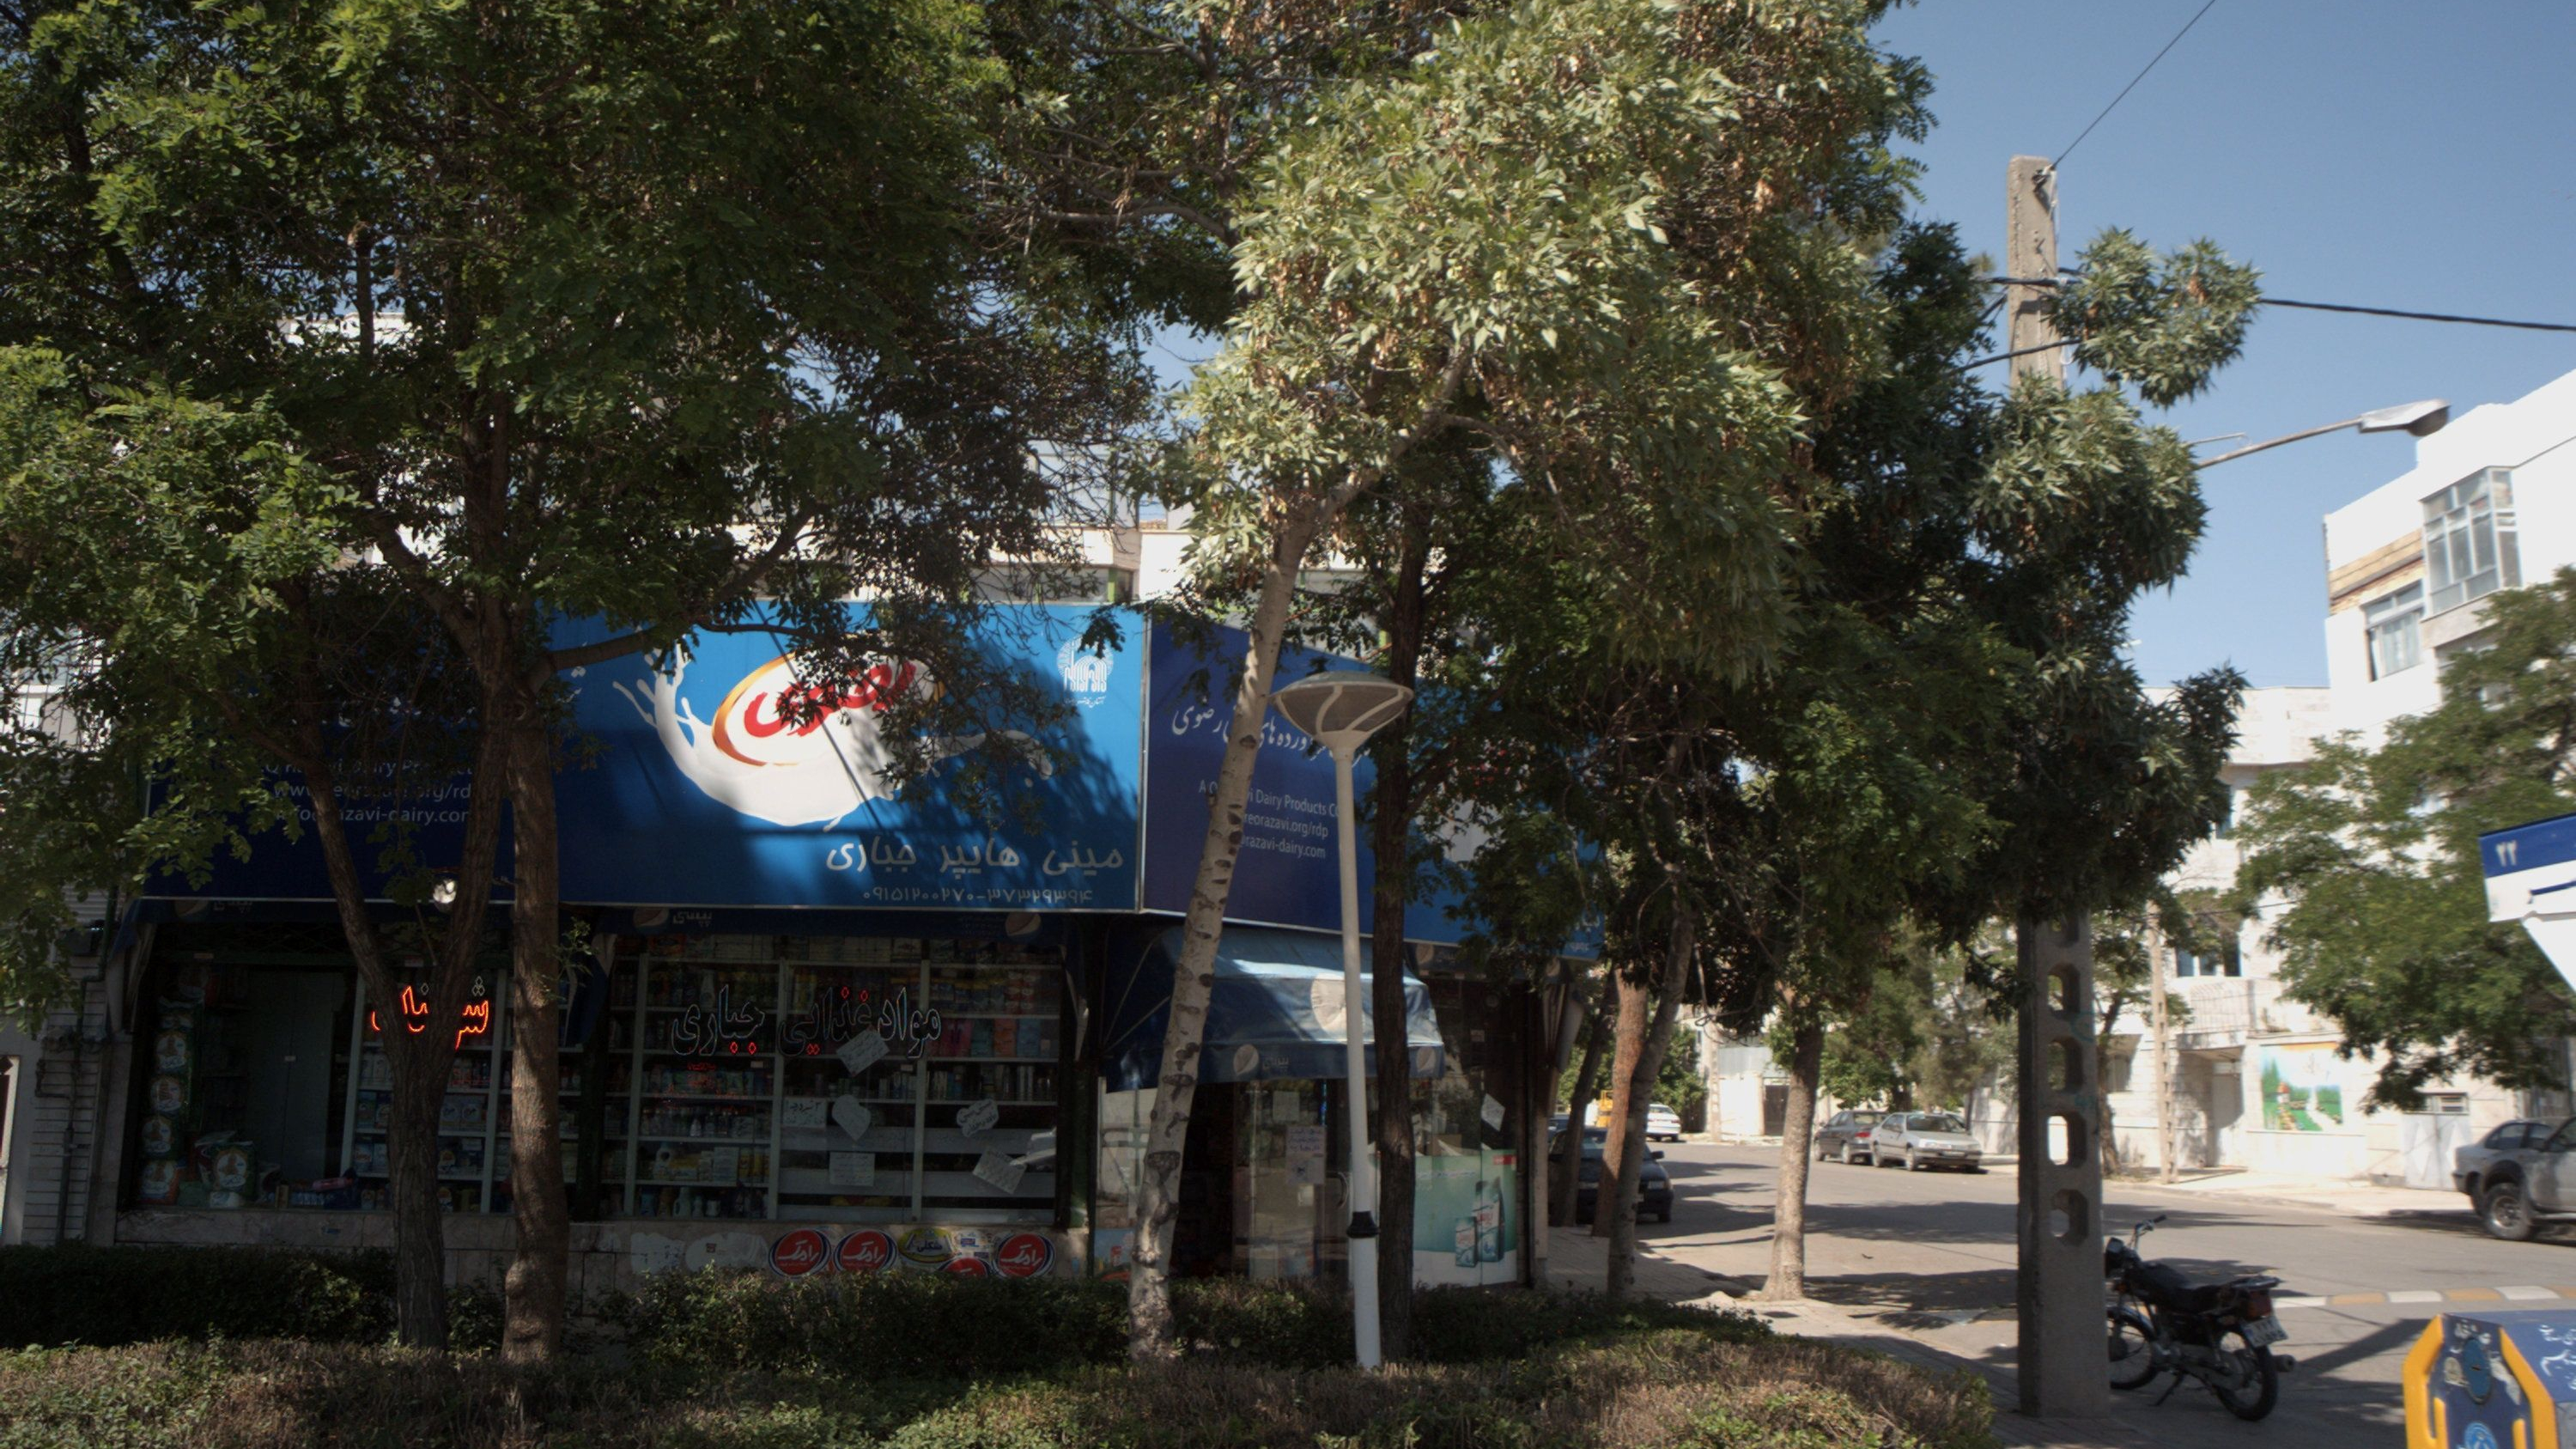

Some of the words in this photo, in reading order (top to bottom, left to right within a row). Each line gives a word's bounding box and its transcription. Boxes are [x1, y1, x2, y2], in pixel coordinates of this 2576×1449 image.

[1171, 697, 1224, 736] رضوی
[1255, 789, 1283, 810] Dairy
[1284, 795, 1327, 815] Products
[826, 835, 917, 874] جباری
[939, 837, 1021, 881] هایپر
[1042, 839, 1125, 877] مینی
[671, 983, 767, 1056] جباری
[875, 985, 943, 1059] مواد
[777, 1239, 820, 1262] رامک
[842, 1240, 885, 1263] رامک
[999, 1244, 1043, 1267] رامک
